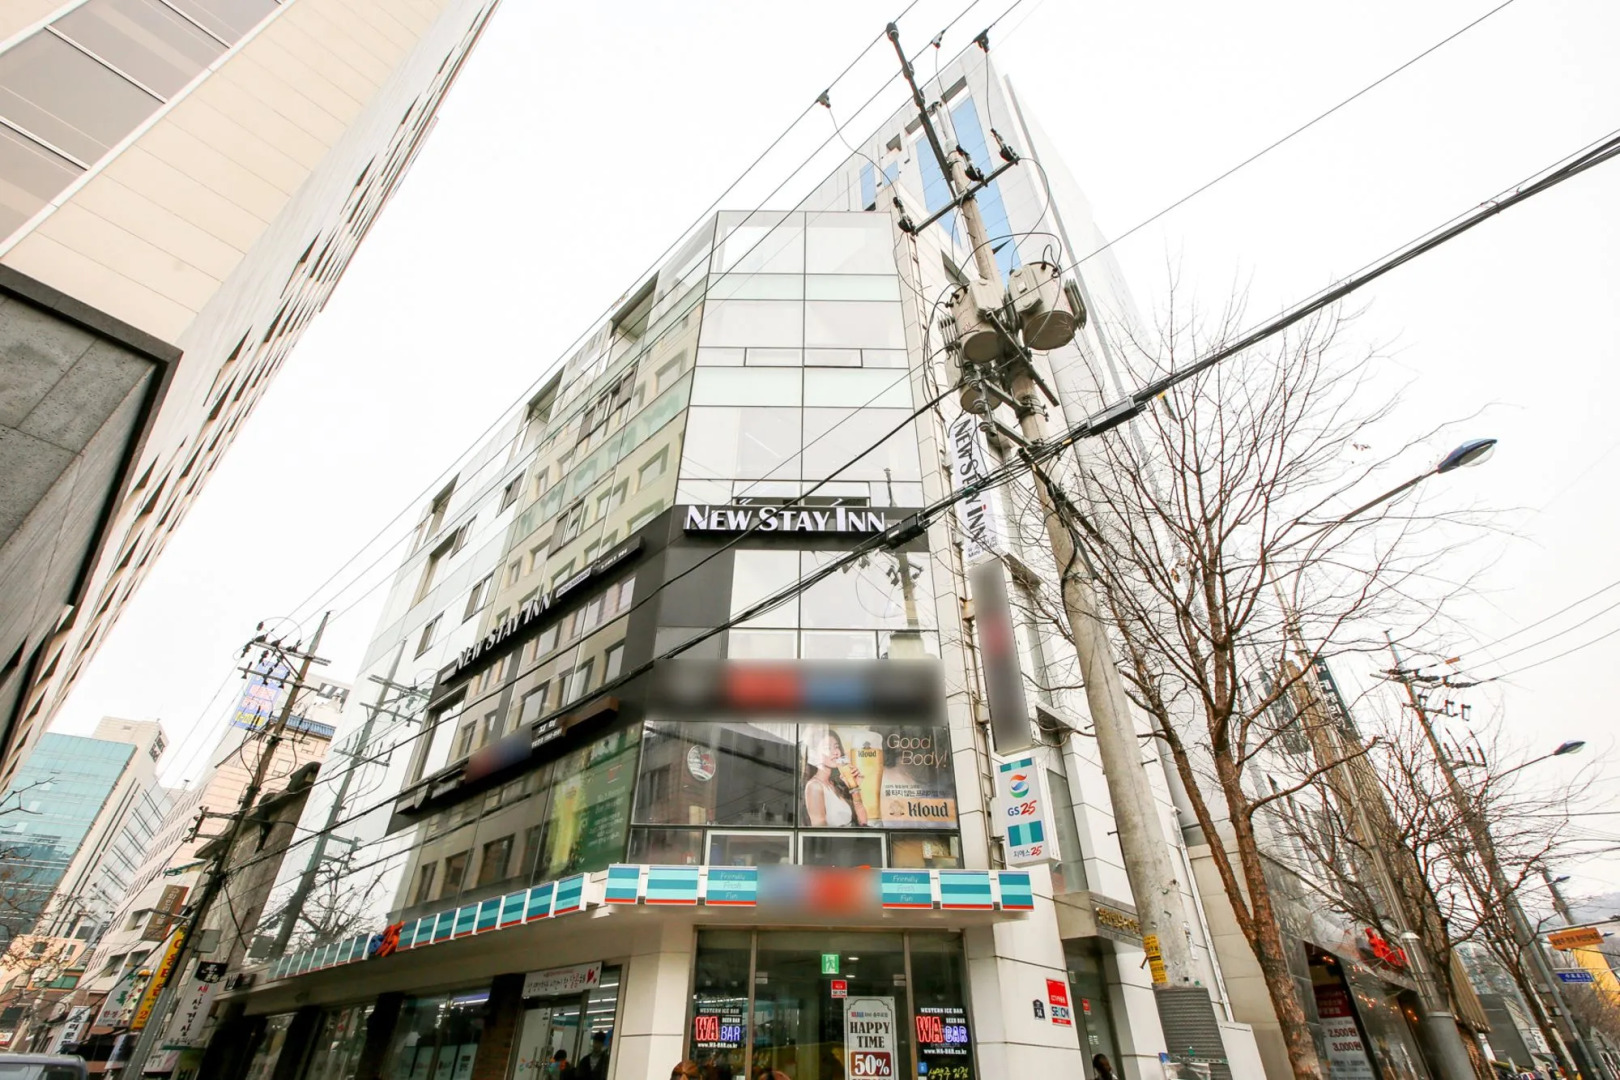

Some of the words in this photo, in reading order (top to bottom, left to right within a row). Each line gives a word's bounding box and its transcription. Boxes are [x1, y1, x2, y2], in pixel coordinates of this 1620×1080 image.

[954, 419, 973, 459] NEW
[960, 459, 982, 504] STY
[686, 505, 752, 530] NEW
[759, 506, 830, 531] STAY
[836, 507, 885, 532] INN
[967, 504, 987, 542] INN
[456, 641, 484, 670] NEW
[485, 613, 521, 651] STAY
[522, 593, 551, 625] INN
[886, 734, 931, 749] Good
[902, 750, 947, 769] Body!
[1007, 799, 1037, 817] GS25
[892, 874, 919, 884] Friendly
[695, 1016, 719, 1041] WA
[721, 1025, 741, 1041] BAR
[850, 1021, 890, 1034] HAPPY
[916, 1016, 943, 1043] WA
[944, 1025, 968, 1043] BAR
[857, 1036, 885, 1048] TIME
[854, 1054, 890, 1076] 50%
